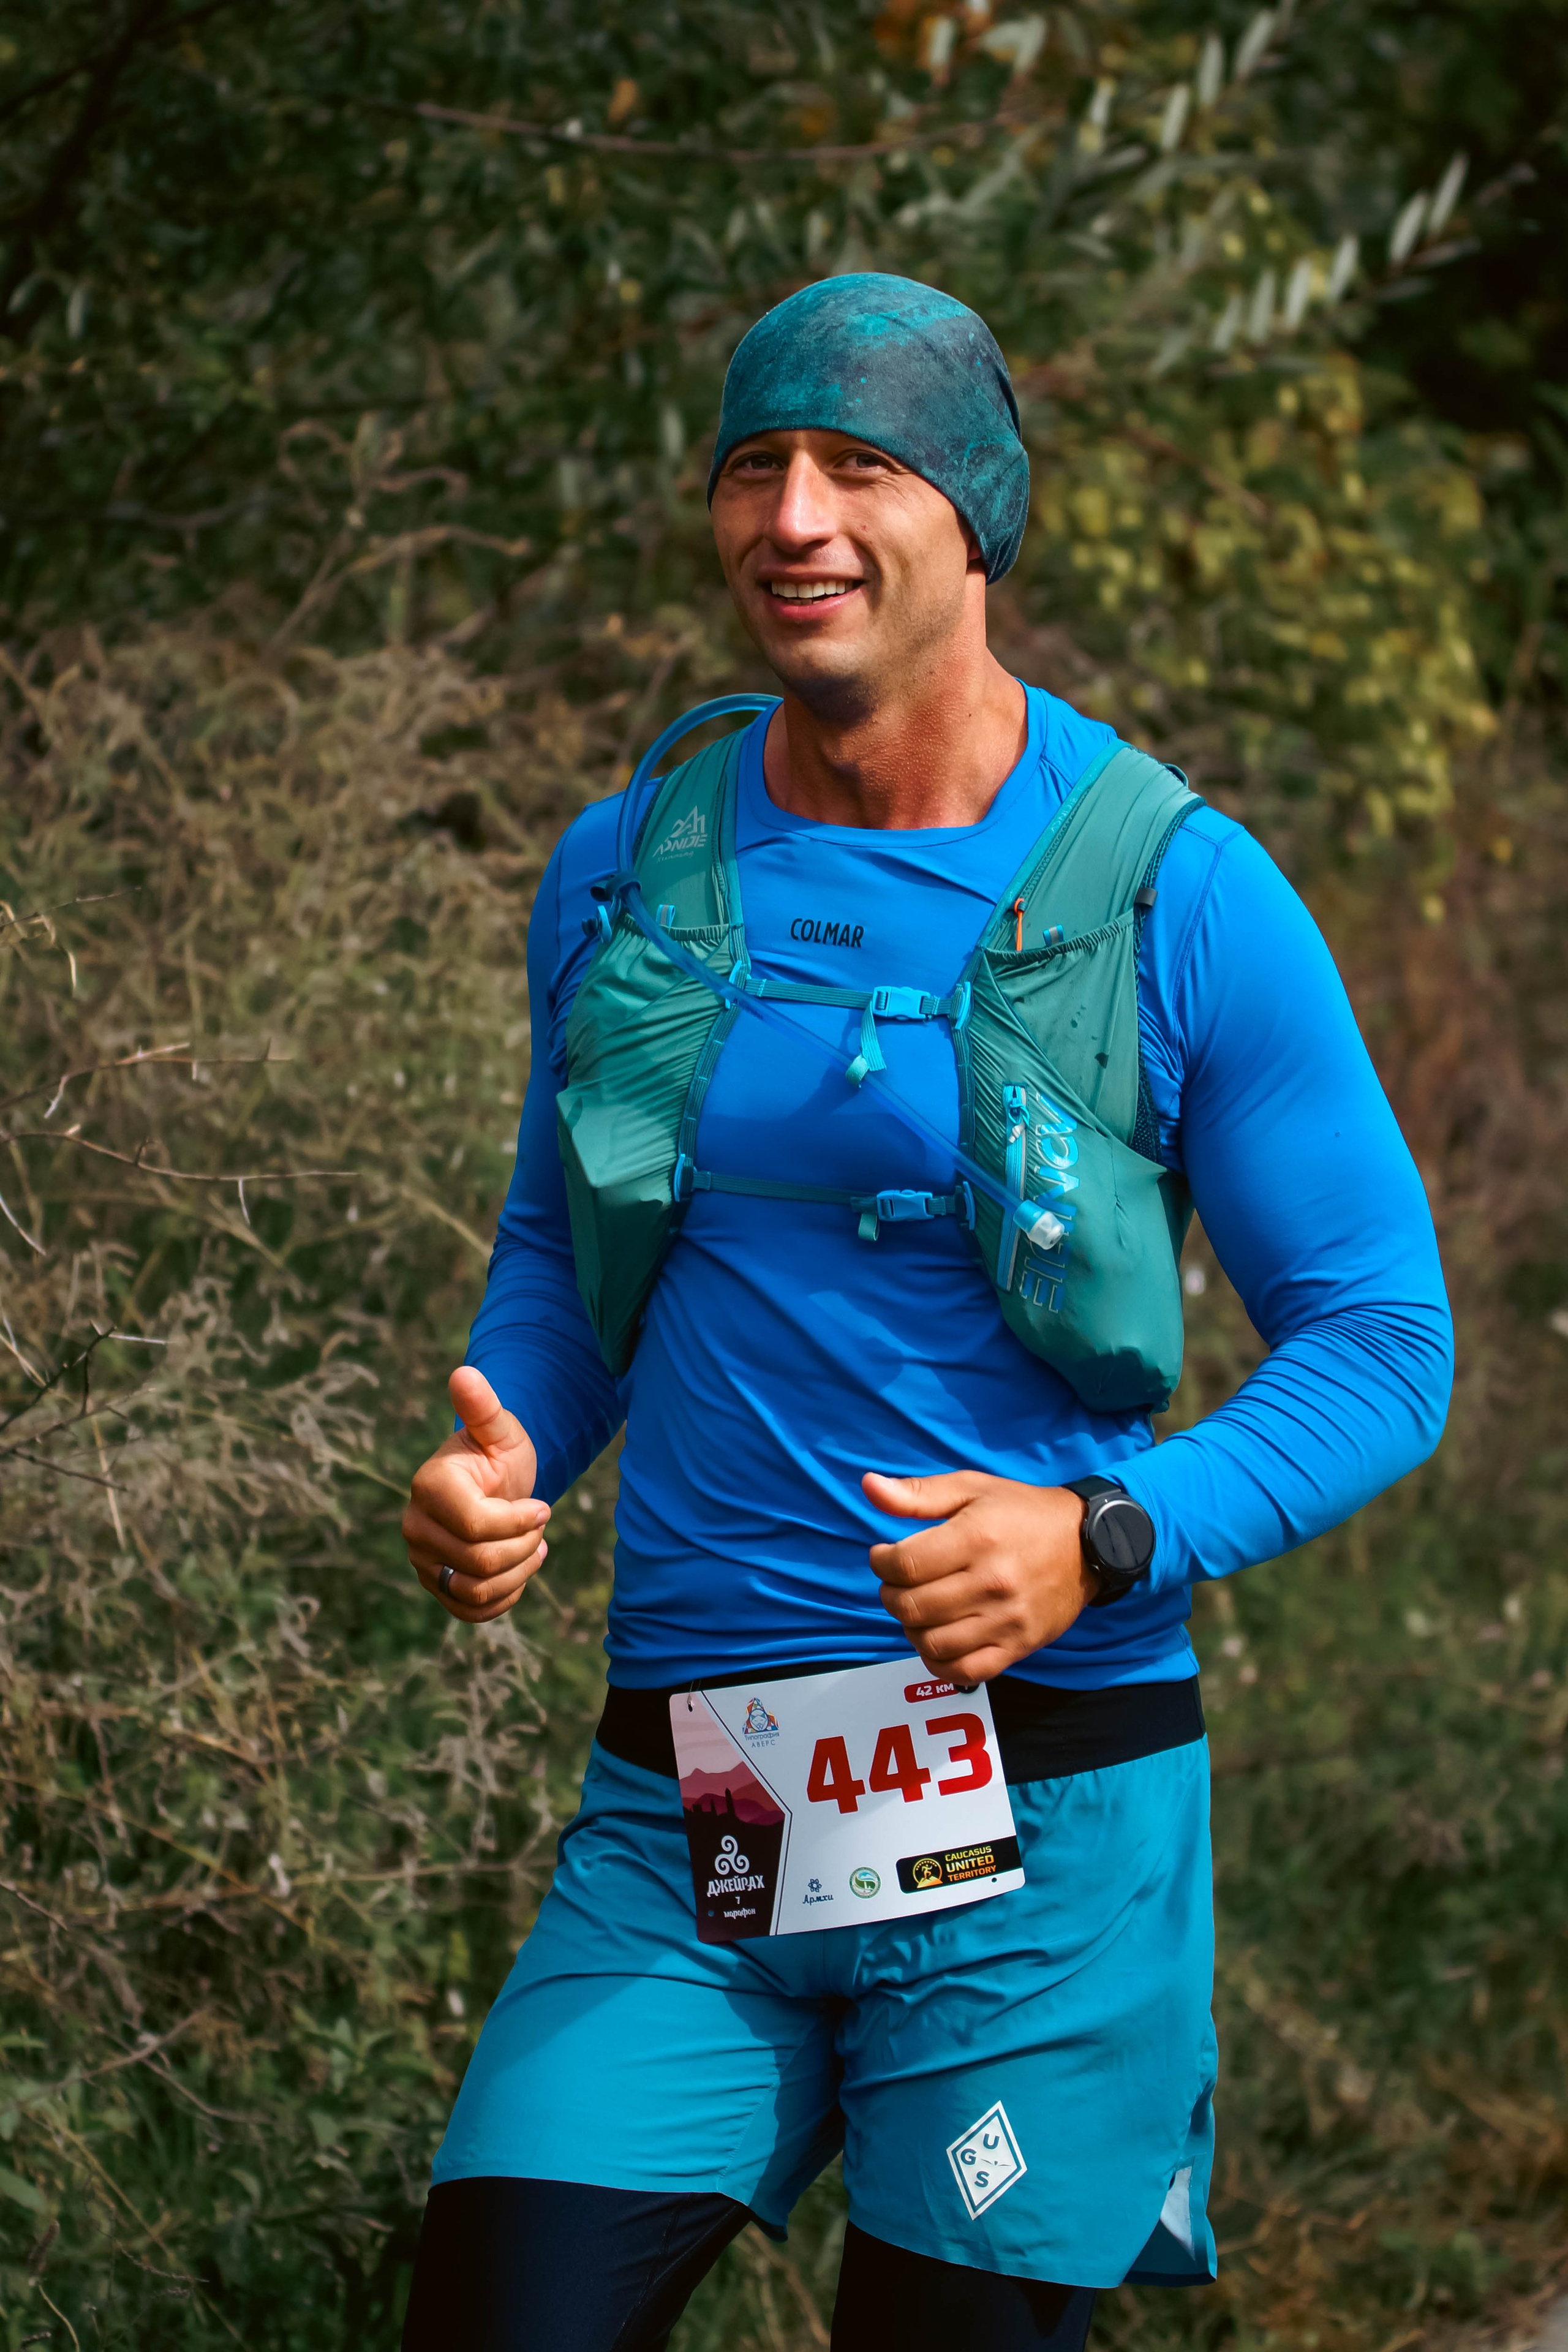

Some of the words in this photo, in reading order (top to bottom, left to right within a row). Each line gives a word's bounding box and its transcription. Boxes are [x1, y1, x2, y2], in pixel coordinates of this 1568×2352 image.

[790, 918, 864, 948] COLMAR
[916, 1685, 933, 1697] 42
[806, 1712, 993, 1814] 443
[944, 1845, 992, 1862] CAUCASUS
[946, 1855, 995, 1873] UNITED
[948, 1865, 997, 1882] TERRITORY
[707, 1875, 765, 1898] ДЖЕЙРАХ
[723, 1907, 756, 1920] марафон
